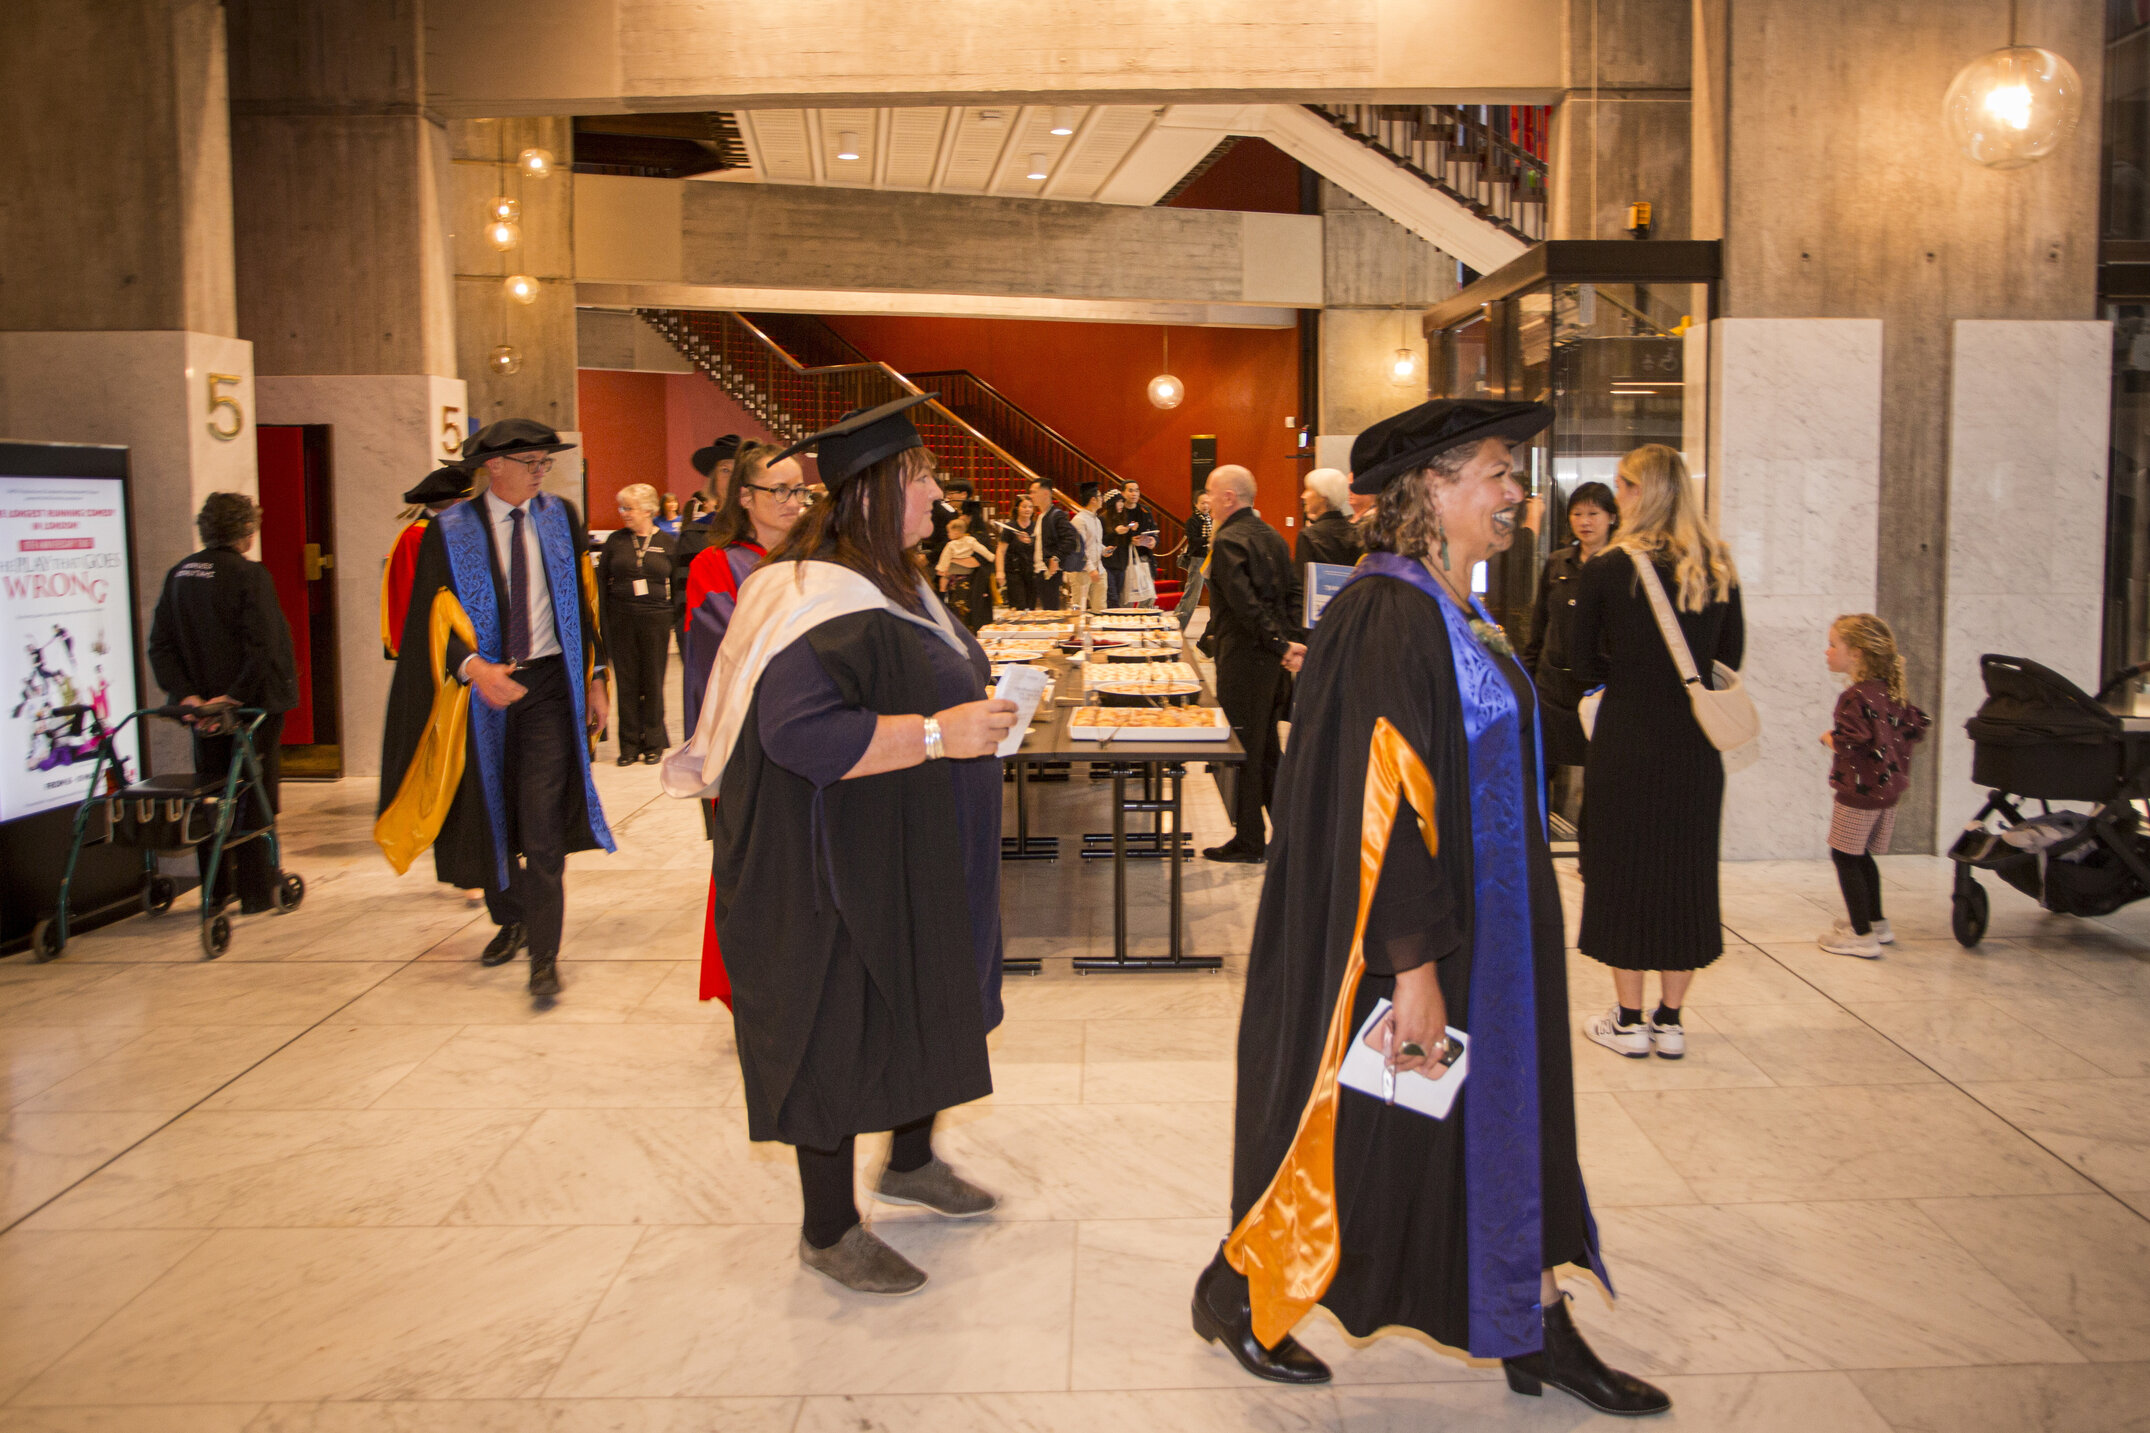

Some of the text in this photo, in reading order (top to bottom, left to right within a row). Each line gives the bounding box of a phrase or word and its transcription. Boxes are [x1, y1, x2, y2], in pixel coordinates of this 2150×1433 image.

[207, 372, 244, 441] 5
[442, 405, 462, 454] 5
[16, 555, 52, 573] PLAY
[82, 552, 121, 570] GOES
[2, 571, 110, 605] WRONG
